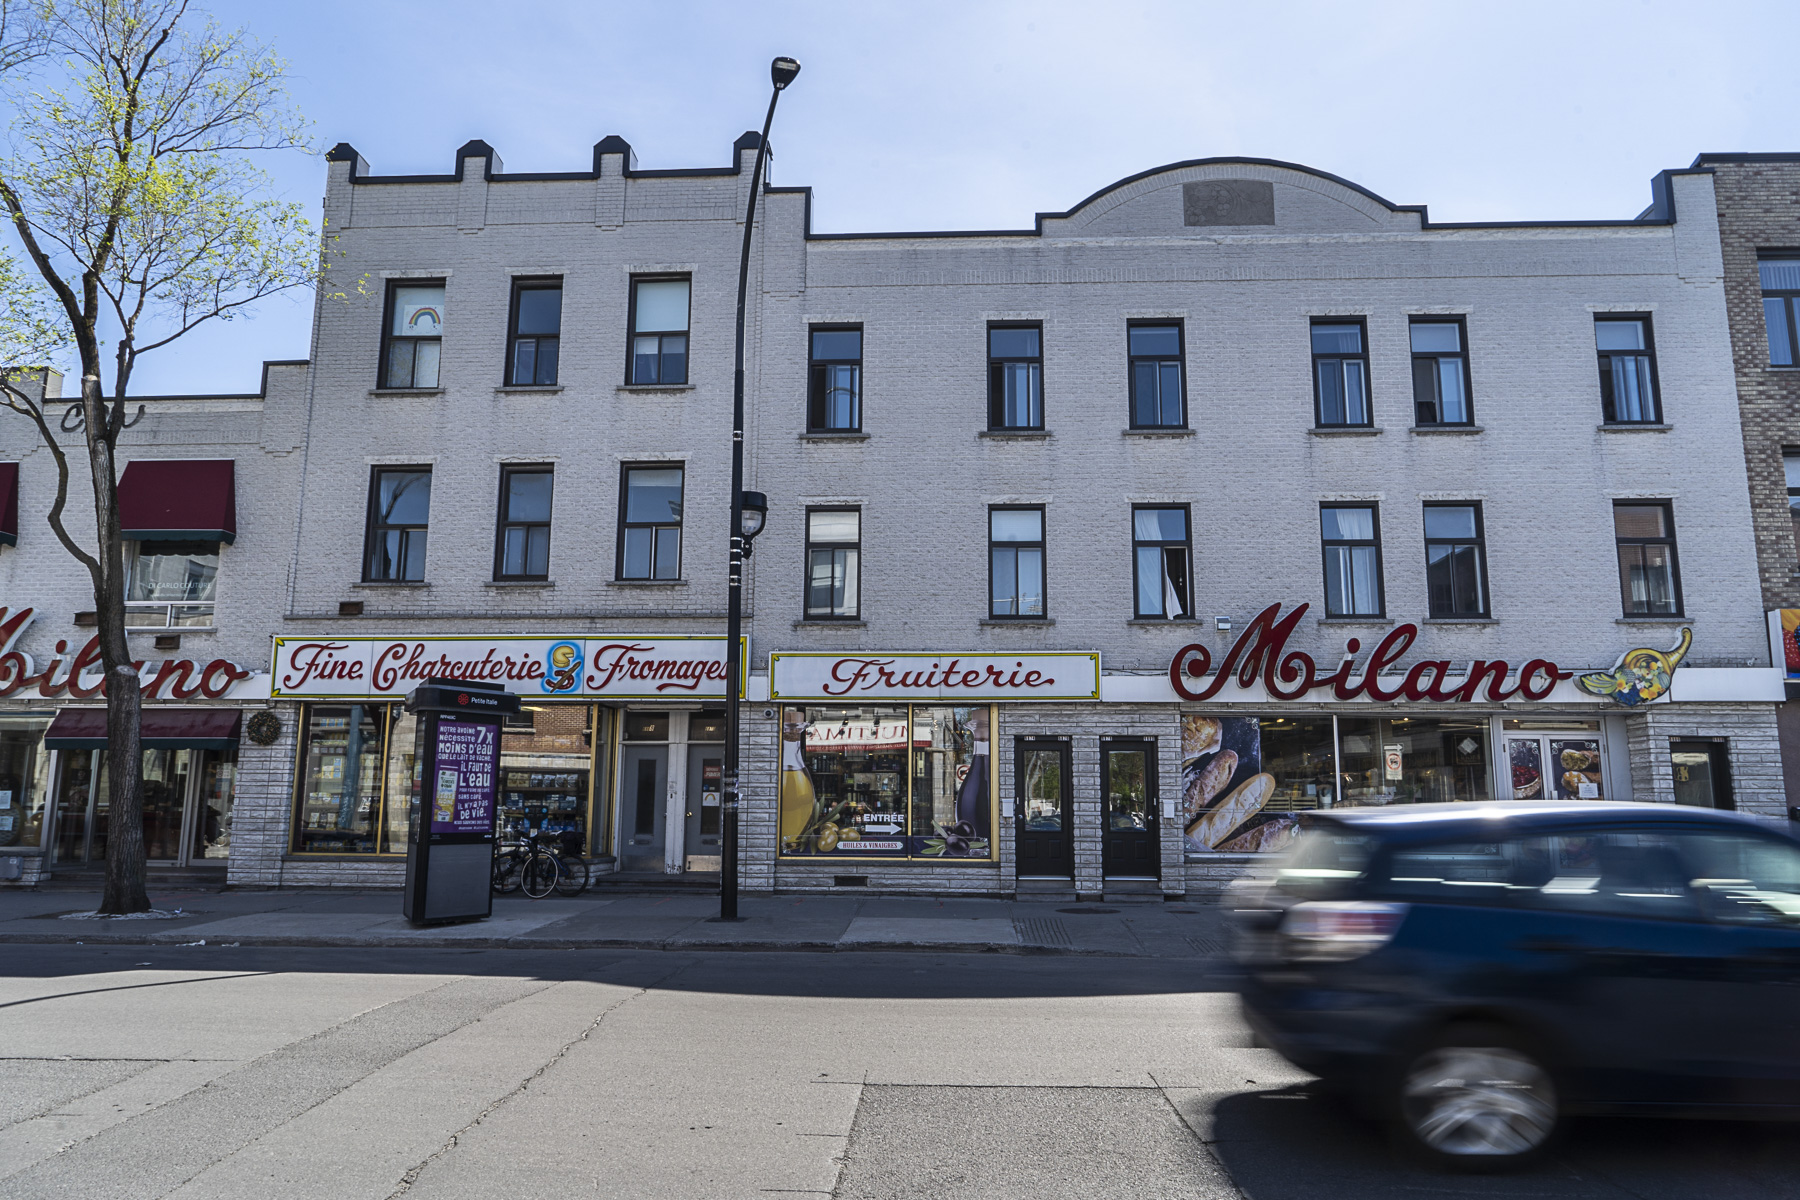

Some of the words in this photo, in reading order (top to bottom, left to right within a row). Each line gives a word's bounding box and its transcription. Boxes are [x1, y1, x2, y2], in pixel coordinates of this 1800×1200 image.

[283, 642, 363, 690] Fine
[372, 643, 546, 691] Charcuterie
[1168, 602, 1574, 702] Milano
[822, 658, 1055, 696] Fruiterie
[863, 812, 905, 823] ENTRÉE
